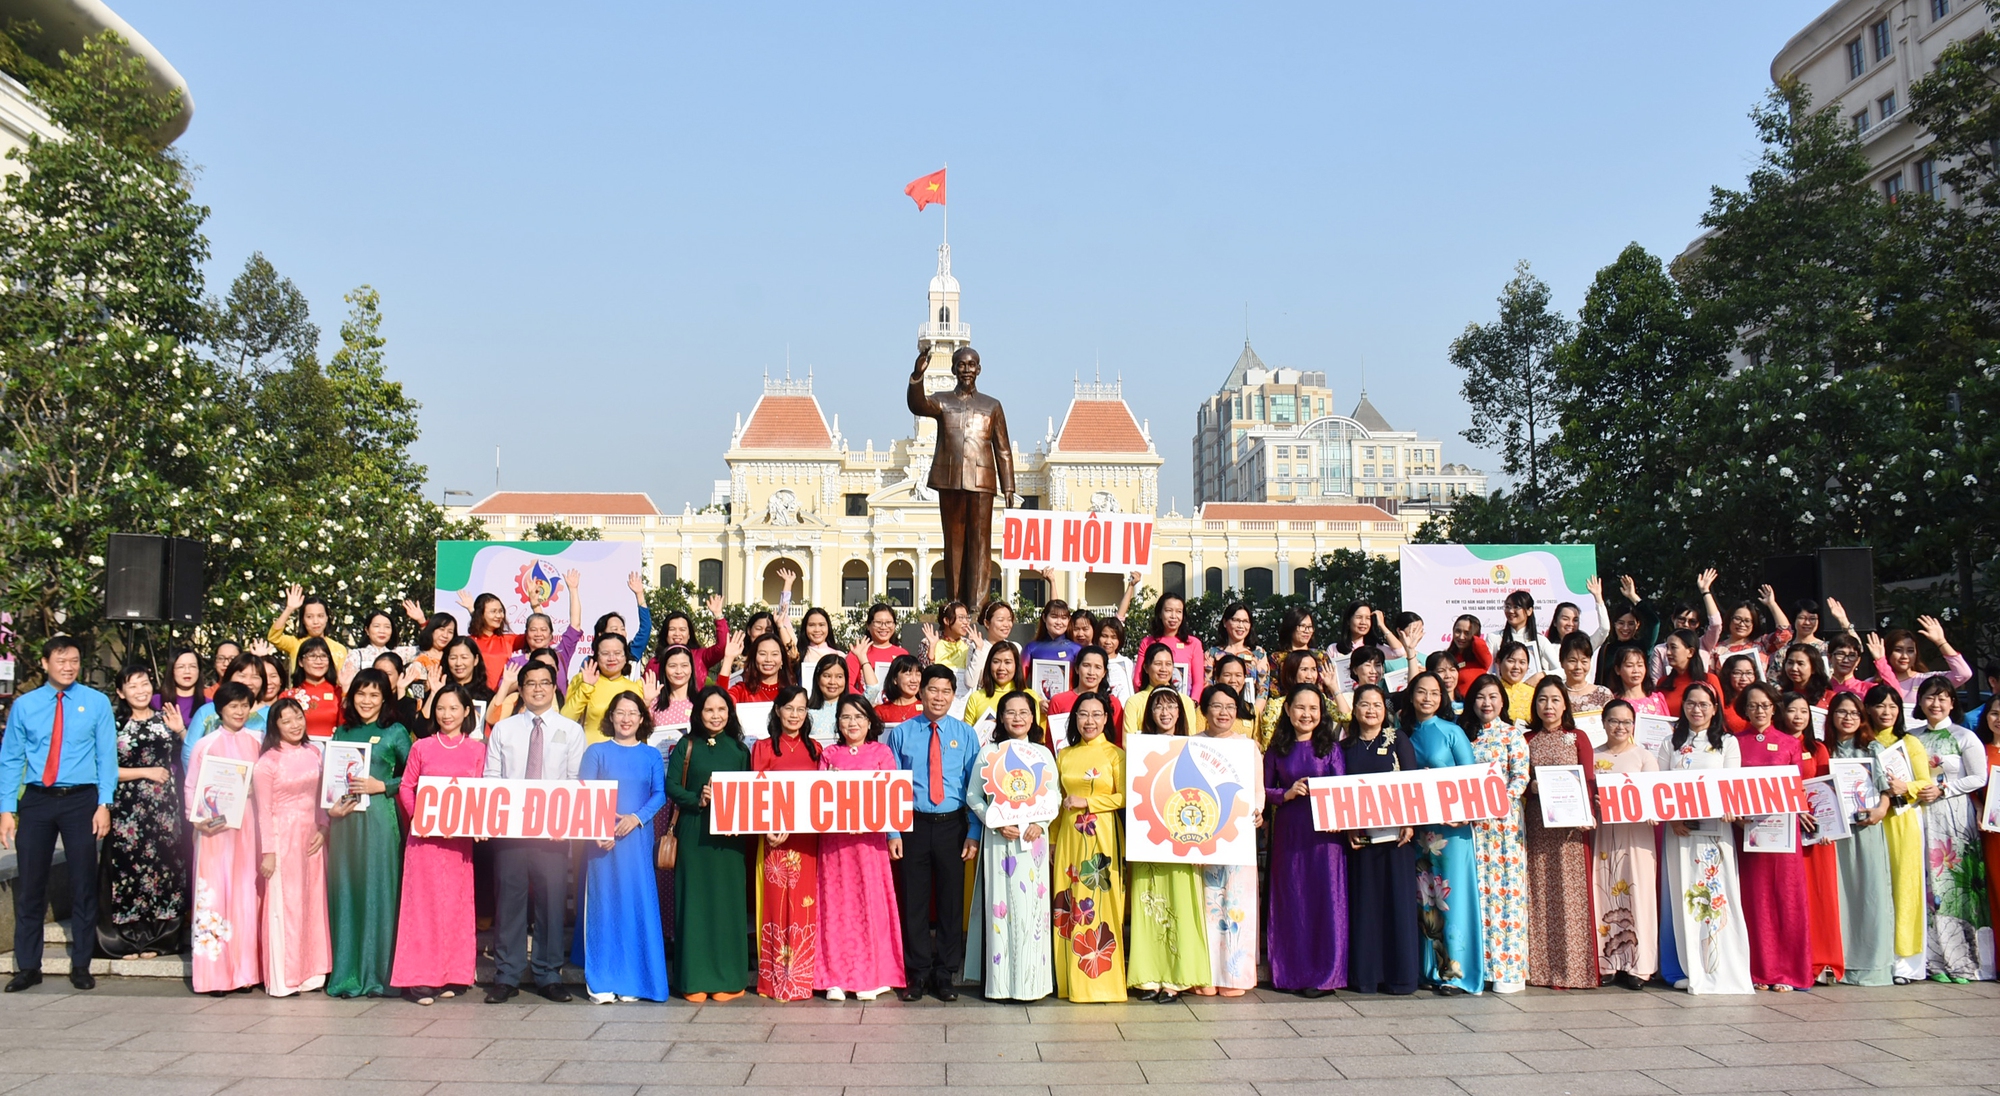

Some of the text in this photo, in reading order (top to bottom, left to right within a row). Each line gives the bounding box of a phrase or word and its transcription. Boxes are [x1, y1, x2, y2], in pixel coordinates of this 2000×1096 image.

[1003, 511, 1153, 573] ĐẠI HỘI IV
[1453, 577, 1471, 585] CÔNG
[1511, 577, 1527, 585] VIÊN
[1528, 577, 1546, 585] CHỨC
[413, 776, 618, 838] CÔNG ĐOÀN
[712, 771, 913, 832] VIÊN CHỨC
[1310, 762, 1510, 830] THÀNH PHỐ
[1598, 772, 1809, 822] HỒ CHÍ MINH
